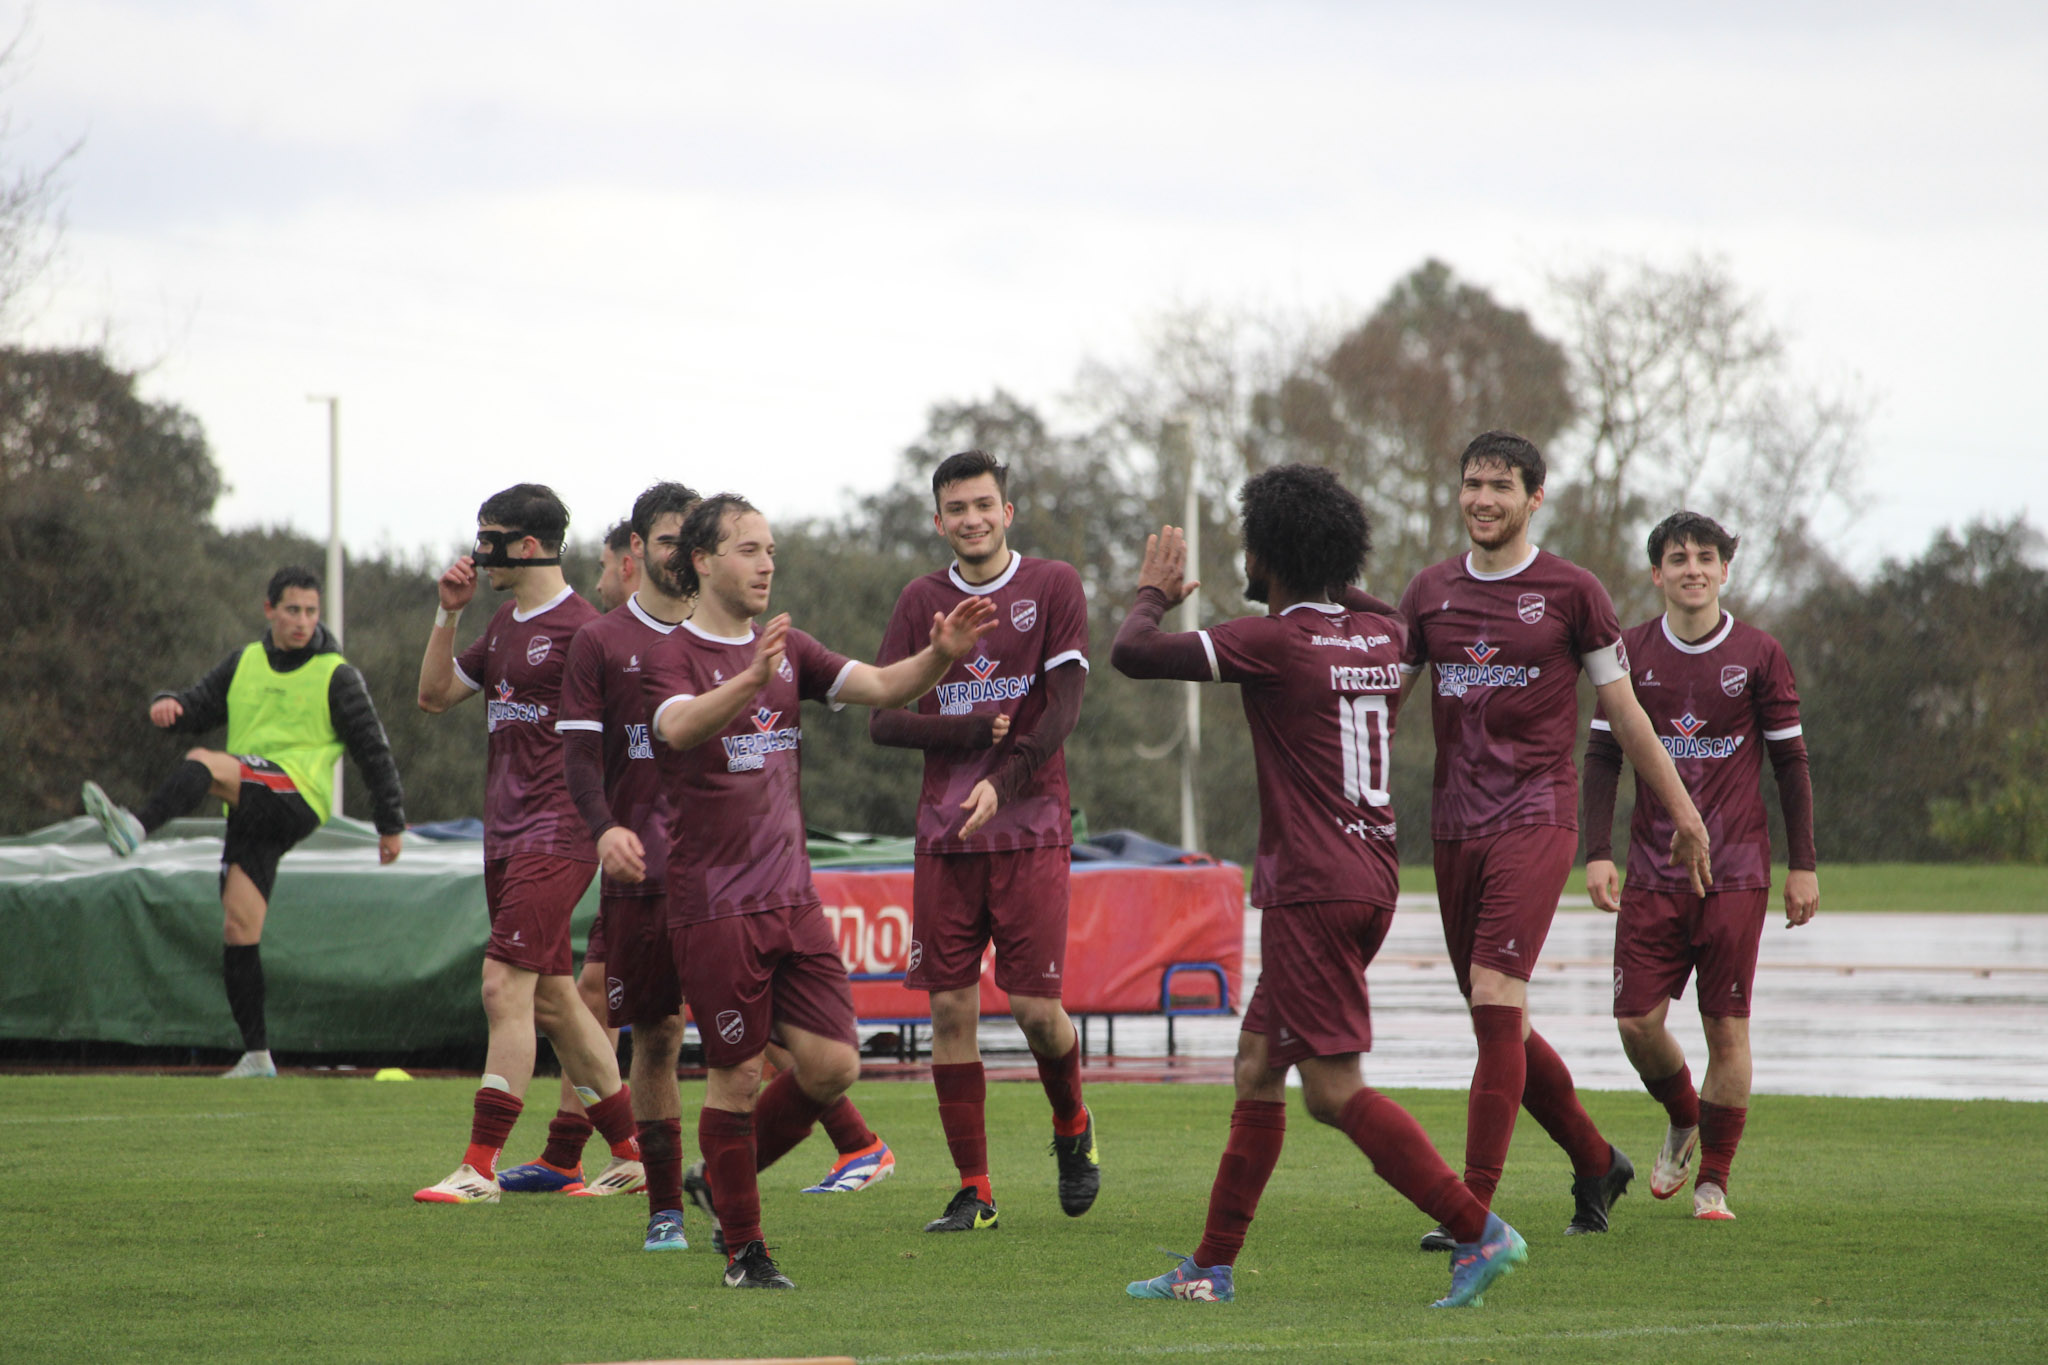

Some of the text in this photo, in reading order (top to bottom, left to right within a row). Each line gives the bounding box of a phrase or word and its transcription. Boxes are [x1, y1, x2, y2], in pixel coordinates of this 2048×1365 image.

[1330, 663, 1401, 691] MARCELO
[1436, 663, 1528, 687] VERDASCA
[936, 674, 1030, 706] VERDASCA
[1339, 695, 1391, 807] 10
[1659, 735, 1736, 758] RDASCA
[727, 755, 765, 773] GROUP
